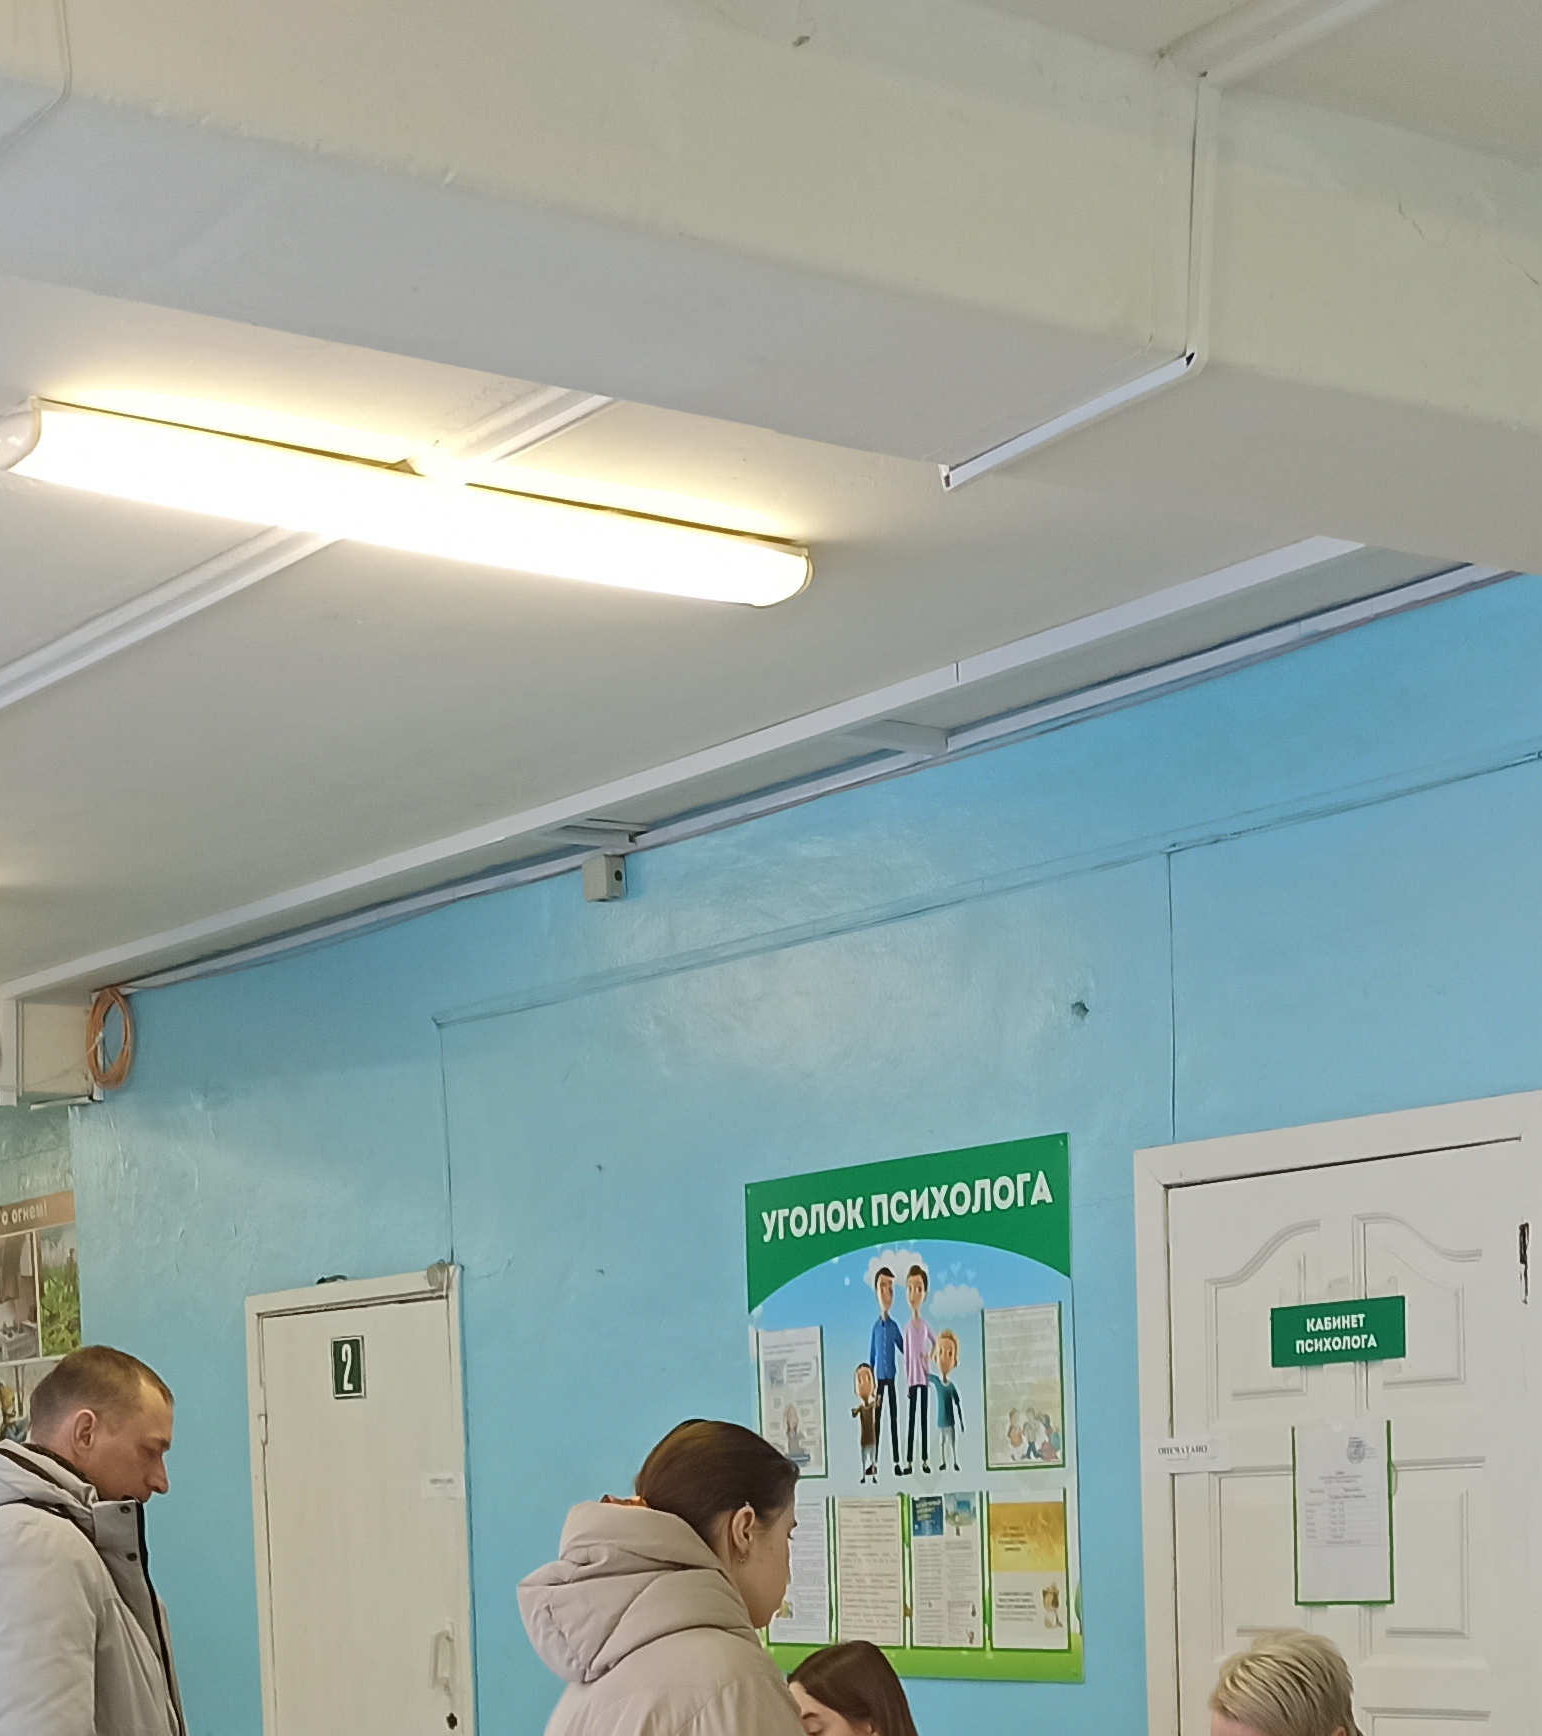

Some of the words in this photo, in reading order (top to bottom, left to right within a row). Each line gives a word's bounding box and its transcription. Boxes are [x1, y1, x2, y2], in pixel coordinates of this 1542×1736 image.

[761, 1197, 865, 1243] УГОЛОК
[871, 1170, 1053, 1227] ПСИХОЛОГА
[1306, 1313, 1366, 1332] КАБИНЕТ
[1295, 1334, 1378, 1354] ПСИХОЛОГА
[341, 1343, 354, 1391] 2
[1158, 1445, 1208, 1455] ОПЕЧАТАНО
